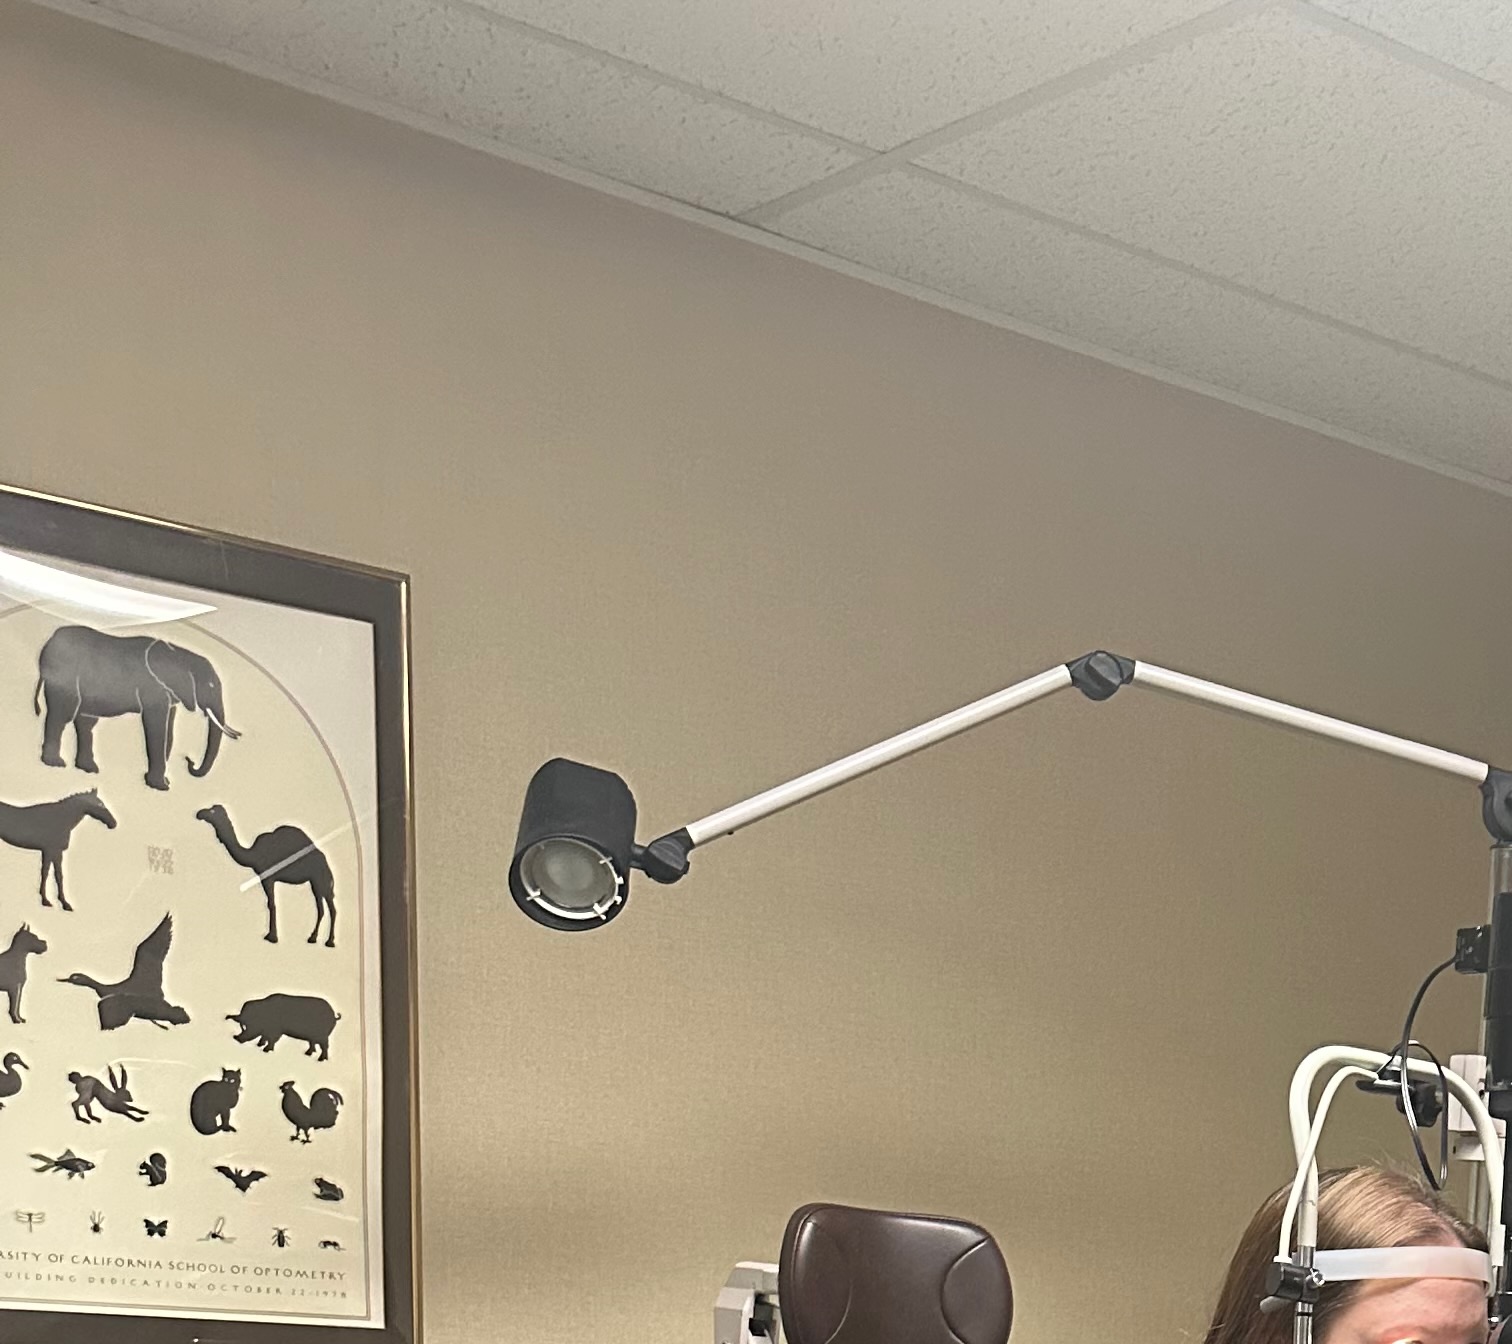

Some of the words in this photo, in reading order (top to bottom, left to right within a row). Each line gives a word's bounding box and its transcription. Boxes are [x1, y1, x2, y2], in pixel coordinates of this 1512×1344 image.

[48, 1253, 65, 1263] OF
[71, 1255, 163, 1270] CALIFORNIA
[168, 1260, 225, 1274] SCHOOL
[230, 1265, 248, 1275] OF
[253, 1266, 346, 1281] OPTOMETRY
[88, 1276, 197, 1290] DEDICATION
[207, 1282, 282, 1295] OCTOBER
